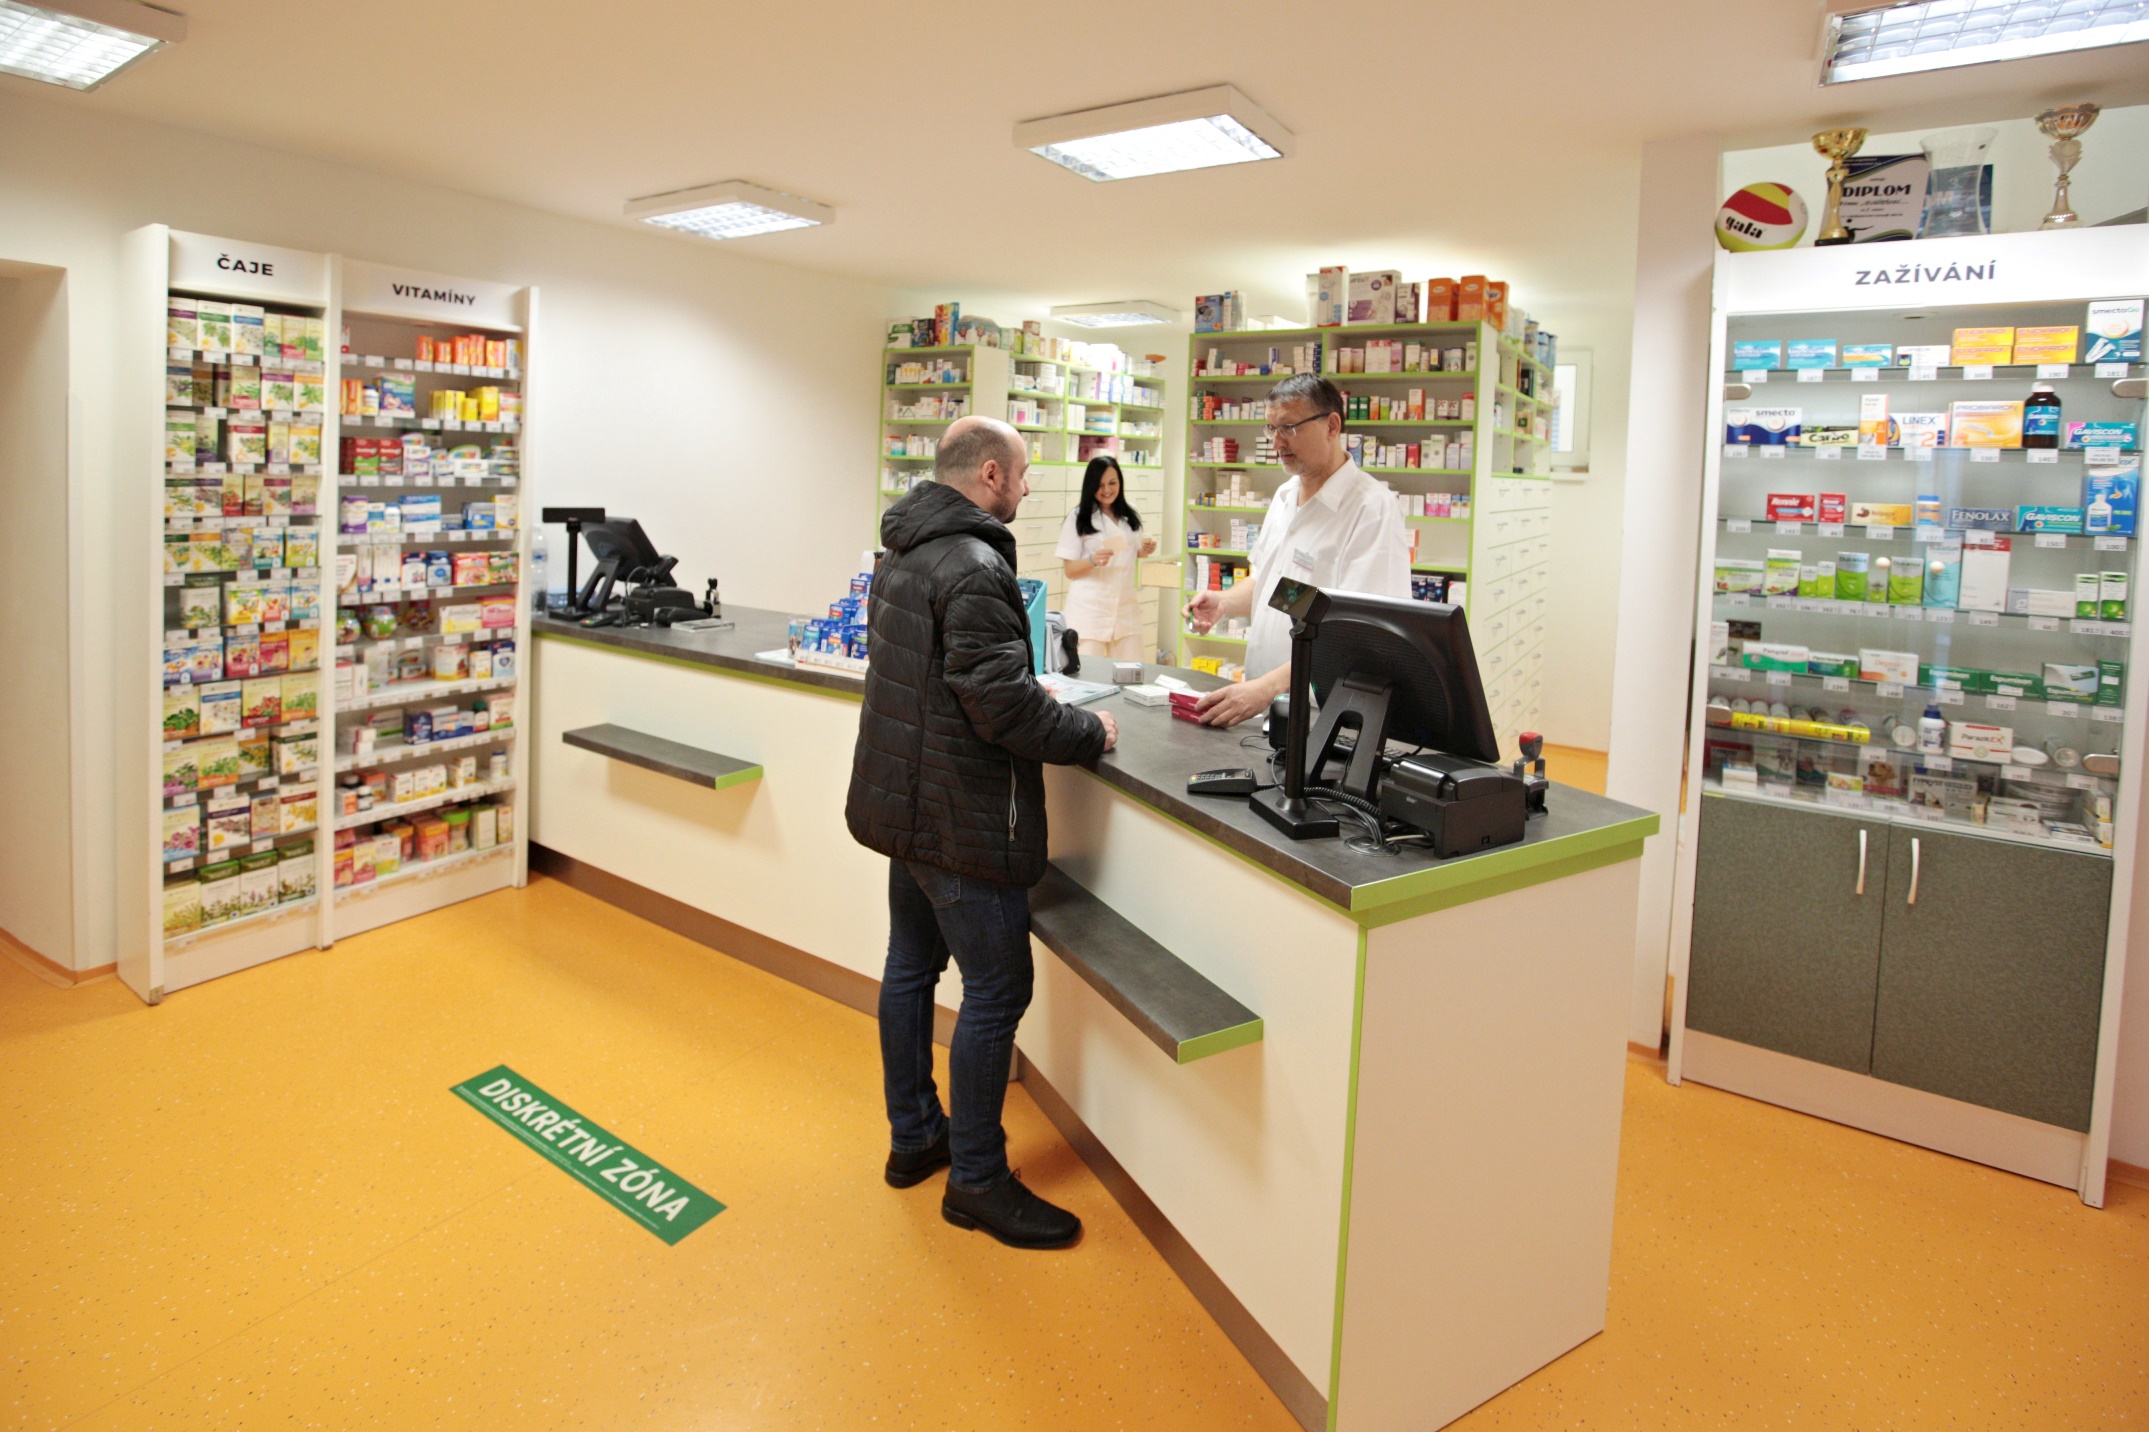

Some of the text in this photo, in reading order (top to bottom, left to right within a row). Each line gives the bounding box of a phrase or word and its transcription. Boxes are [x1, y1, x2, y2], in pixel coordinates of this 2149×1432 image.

[1842, 184, 1912, 197] DIPLOM
[1725, 216, 1764, 239] gala
[217, 253, 274, 276] ČAJE
[1855, 260, 1996, 286] ZAŽÍVÁNÍ
[392, 283, 475, 306] VITAMÍNY
[1902, 416, 1936, 425] LINEX
[1952, 510, 2010, 522] FENOLAX
[2025, 513, 2081, 522] GAVISCON
[478, 1078, 624, 1168] DISKRÉTNÍ
[600, 1158, 690, 1222] ZÓNA
